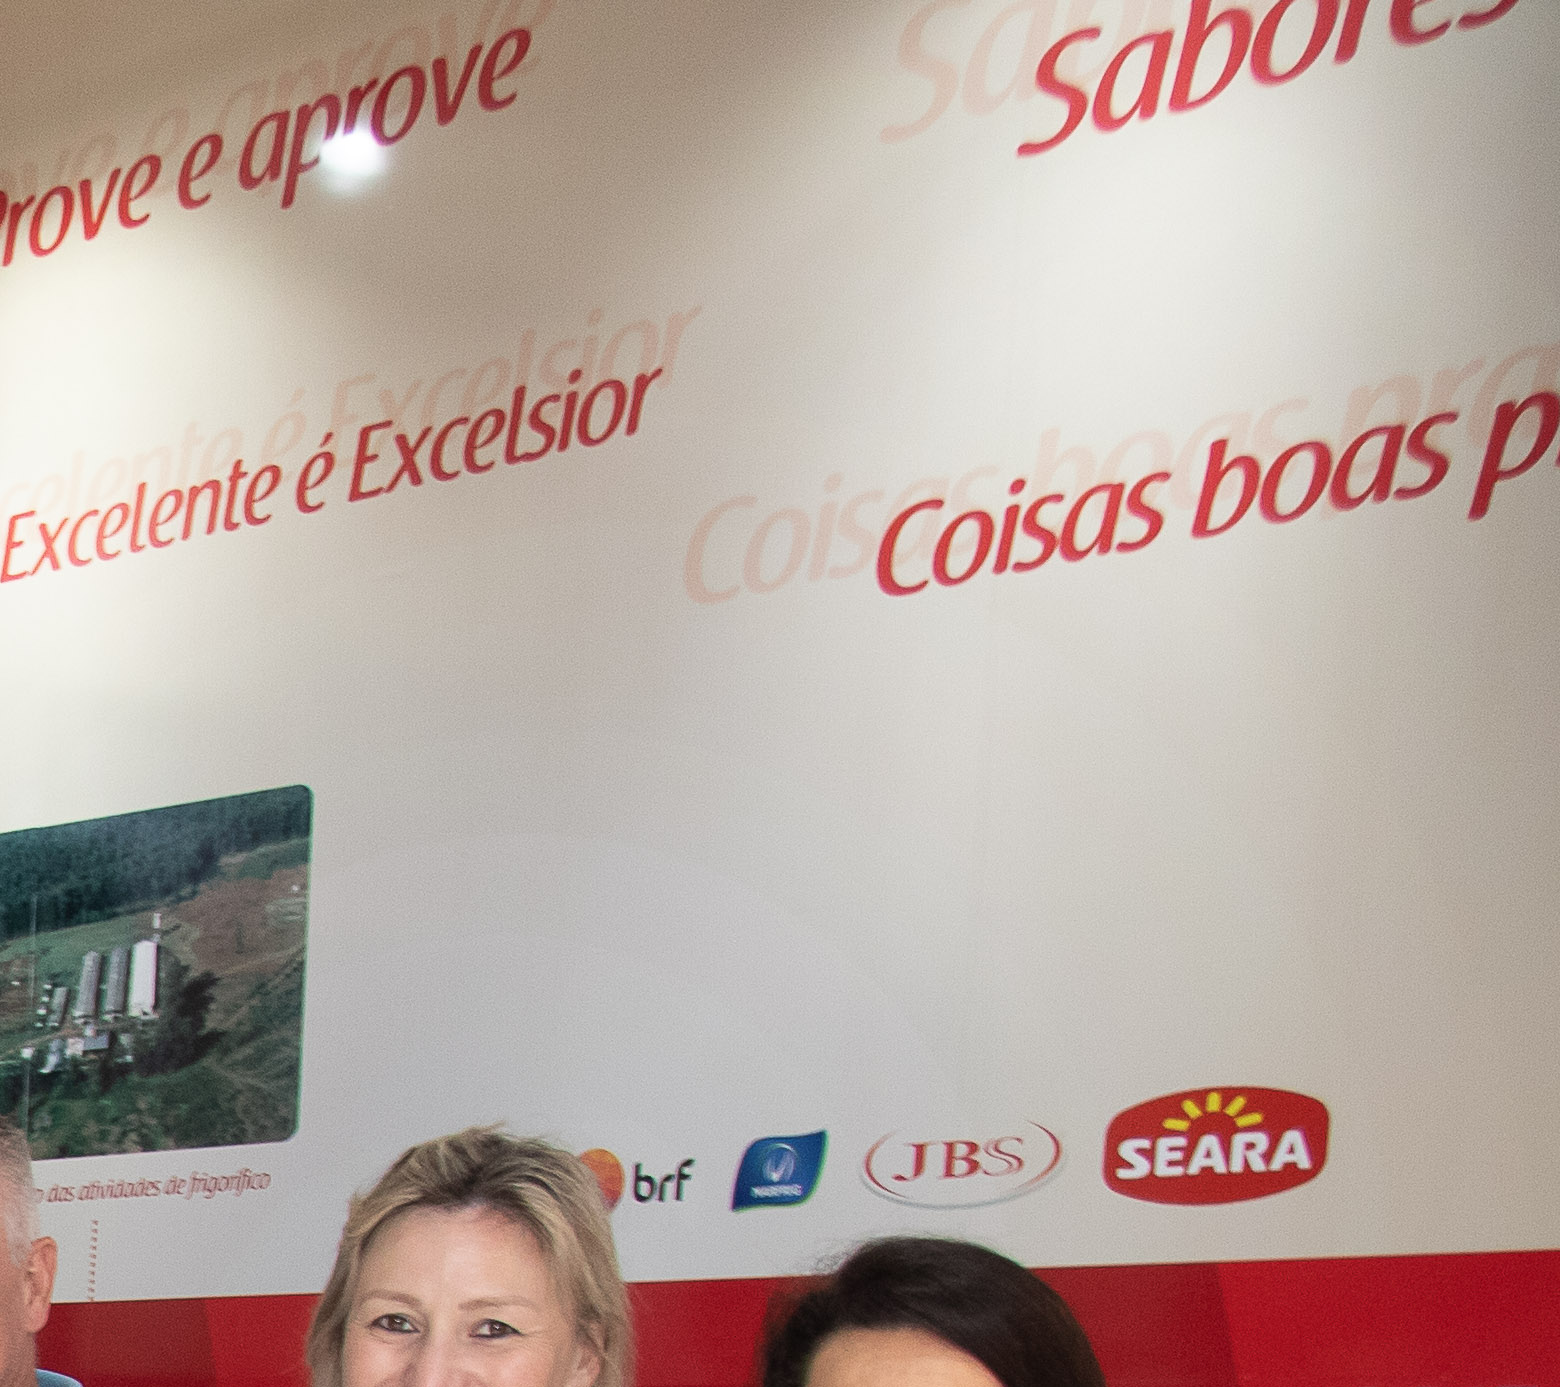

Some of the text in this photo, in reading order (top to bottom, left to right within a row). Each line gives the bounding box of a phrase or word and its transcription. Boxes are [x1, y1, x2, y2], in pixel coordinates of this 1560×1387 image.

[176, 132, 223, 211] e
[237, 27, 532, 209] aprove
[294, 432, 336, 514] é
[347, 367, 663, 502] Excelsior
[875, 389, 1560, 597] Coisas boas p
[633, 1158, 695, 1202] brf
[891, 1136, 1025, 1183] JBS
[1116, 1129, 1313, 1180] SEARA
[47, 1184, 75, 1203] das
[77, 1178, 161, 1201] atividades
[164, 1175, 186, 1196] de
[187, 1167, 271, 1201] frigorífico
